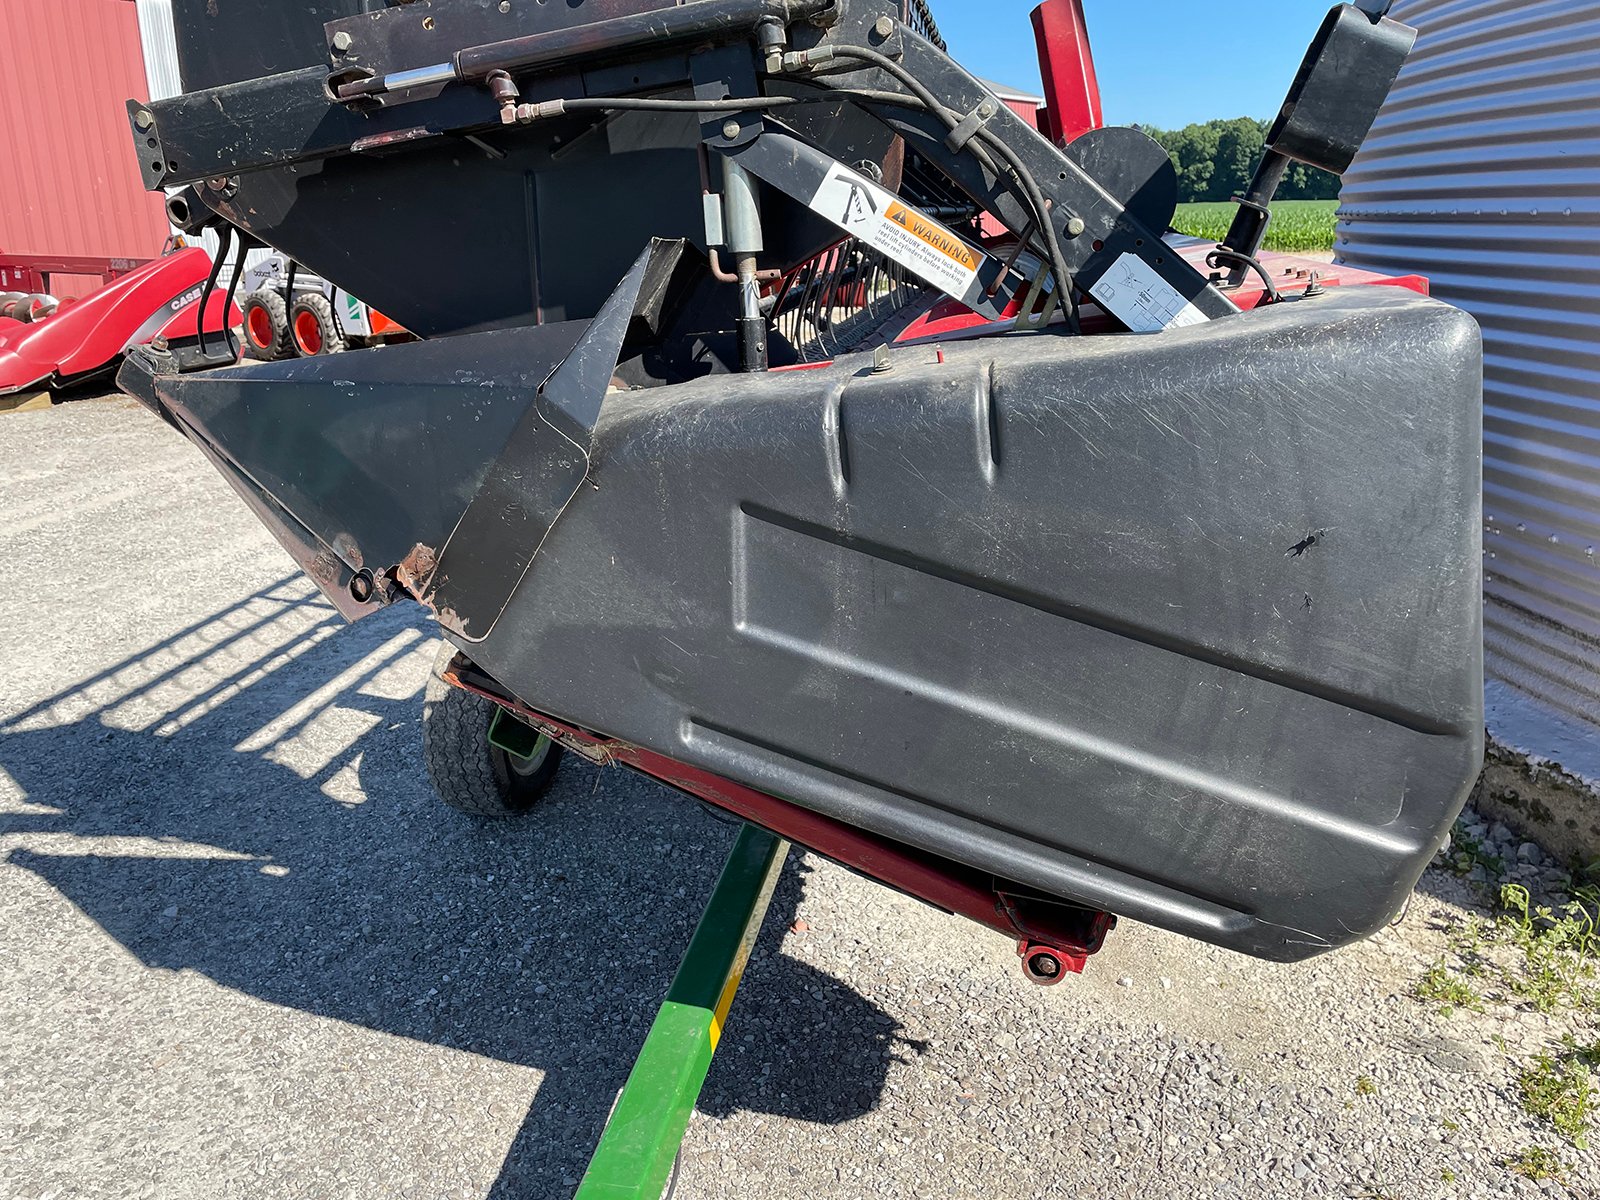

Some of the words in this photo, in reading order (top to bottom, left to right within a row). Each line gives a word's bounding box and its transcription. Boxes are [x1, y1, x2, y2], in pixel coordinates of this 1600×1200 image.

[874, 236, 891, 248] under
[877, 229, 890, 239] reel
[890, 235, 899, 244] lift
[897, 241, 923, 260] cylinders
[922, 256, 941, 271] before
[940, 268, 963, 286] working
[881, 222, 900, 236] AVOID
[921, 246, 941, 263] Always
[941, 259, 954, 270] lock
[953, 267, 967, 278] both
[913, 221, 971, 264] WARNING
[171, 287, 202, 310] CASE
